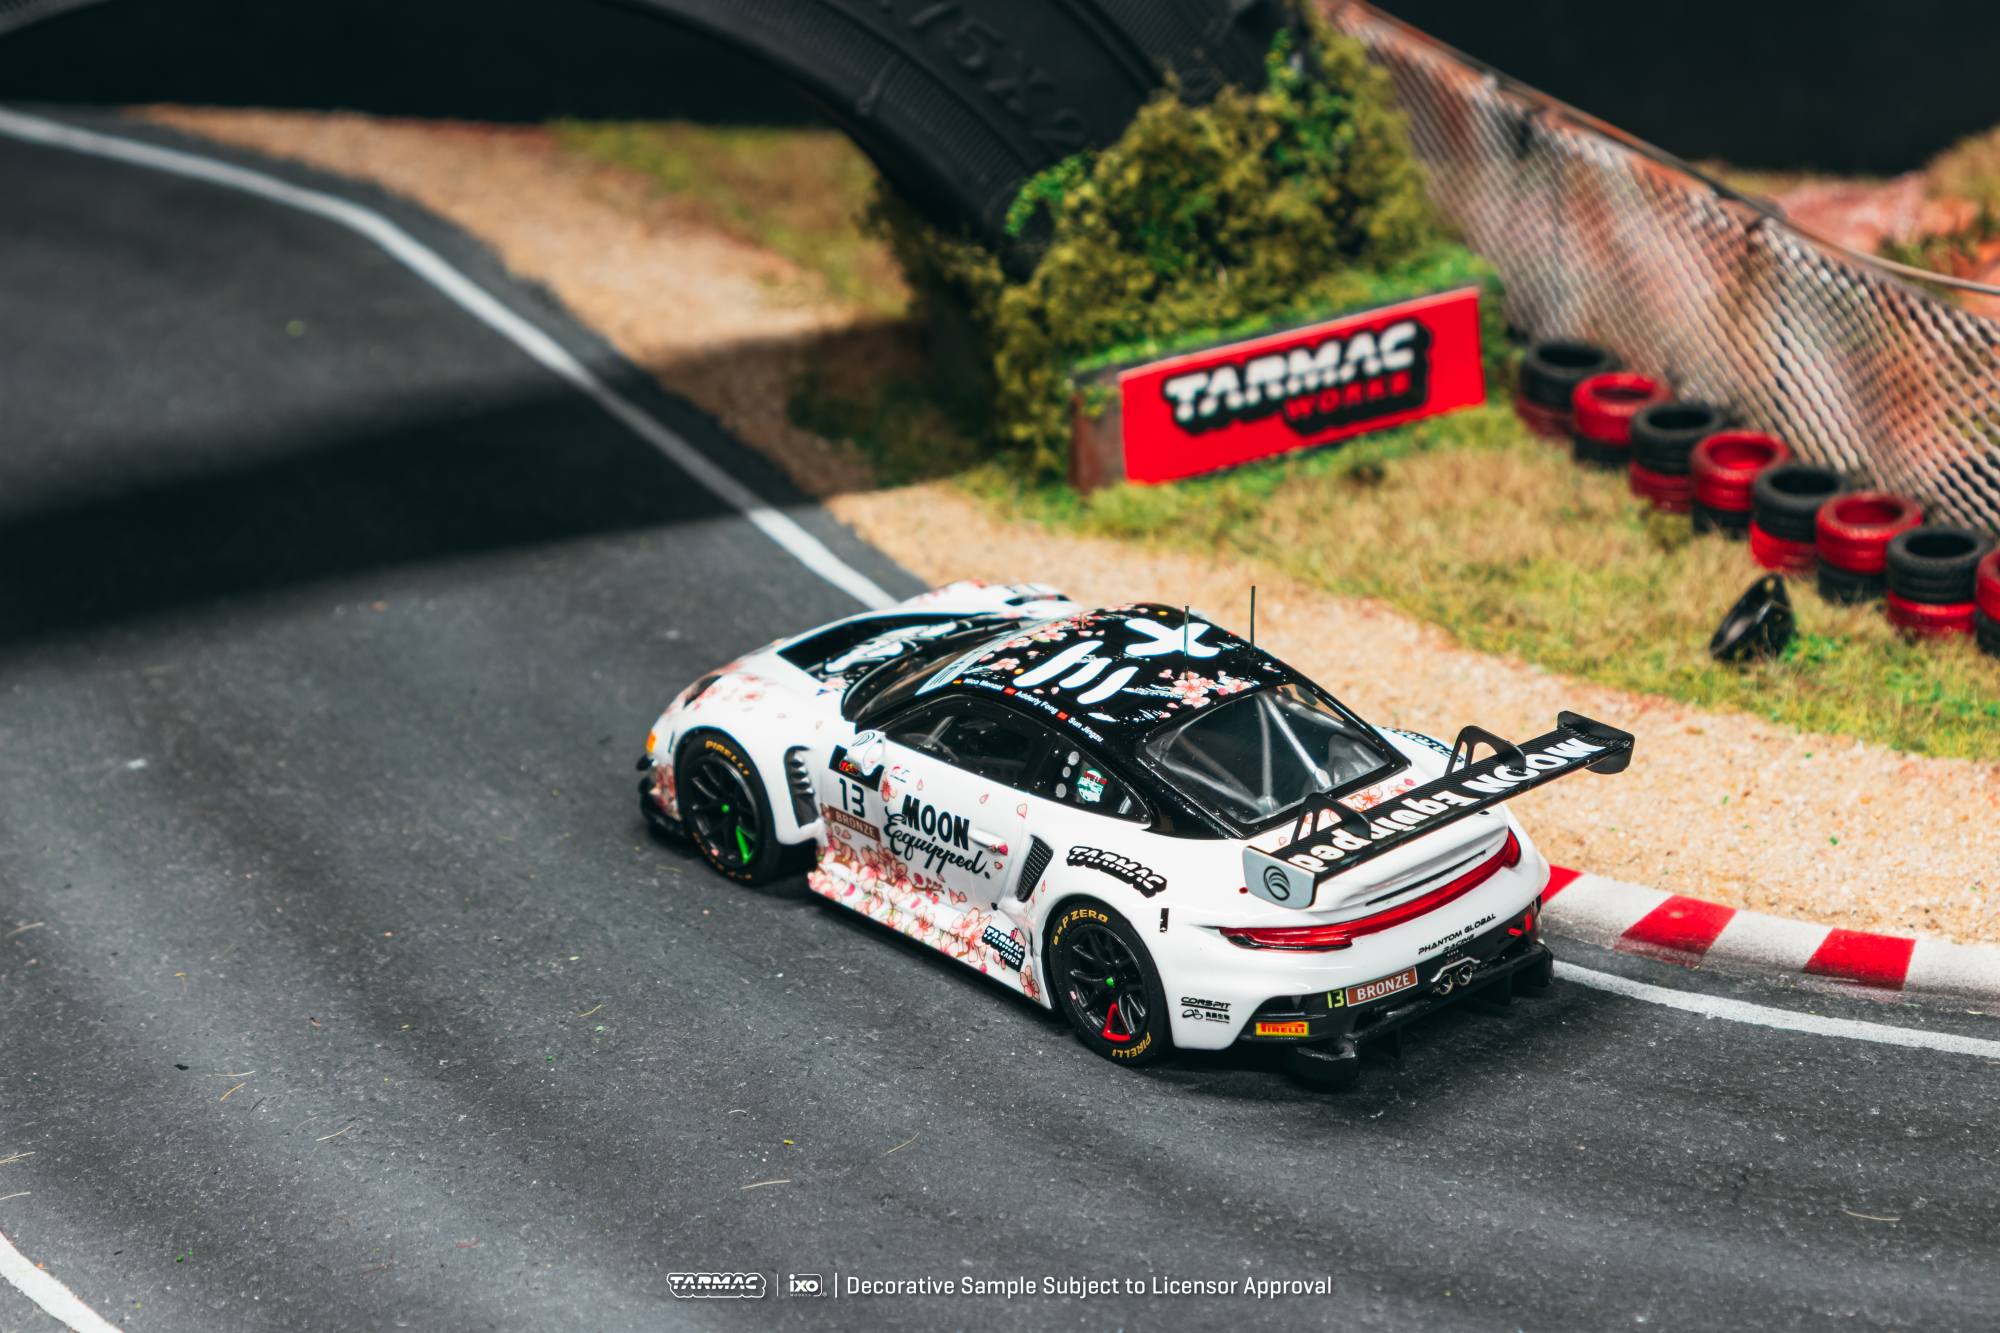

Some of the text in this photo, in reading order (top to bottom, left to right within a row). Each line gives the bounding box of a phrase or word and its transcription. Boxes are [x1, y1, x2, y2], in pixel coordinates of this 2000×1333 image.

[1163, 320, 1418, 422] TARMAC
[1040, 701, 1060, 715] Fong
[1068, 716, 1083, 729] Sun
[1461, 737, 1607, 794] MOON
[839, 777, 866, 819] 13
[834, 810, 876, 840] BRONZE
[902, 794, 970, 851] MOON
[1066, 846, 1167, 897] TARMAC
[1062, 909, 1109, 929] P ZERO
[1418, 929, 1463, 955] PHANTOM
[1464, 913, 1497, 934] GLOBAL
[1000, 950, 1020, 966] CARDS
[1327, 972, 1410, 1009] 13 BRONZE
[1111, 1031, 1152, 1058] PIRELLI
[1260, 1021, 1305, 1034] PIRELLI
